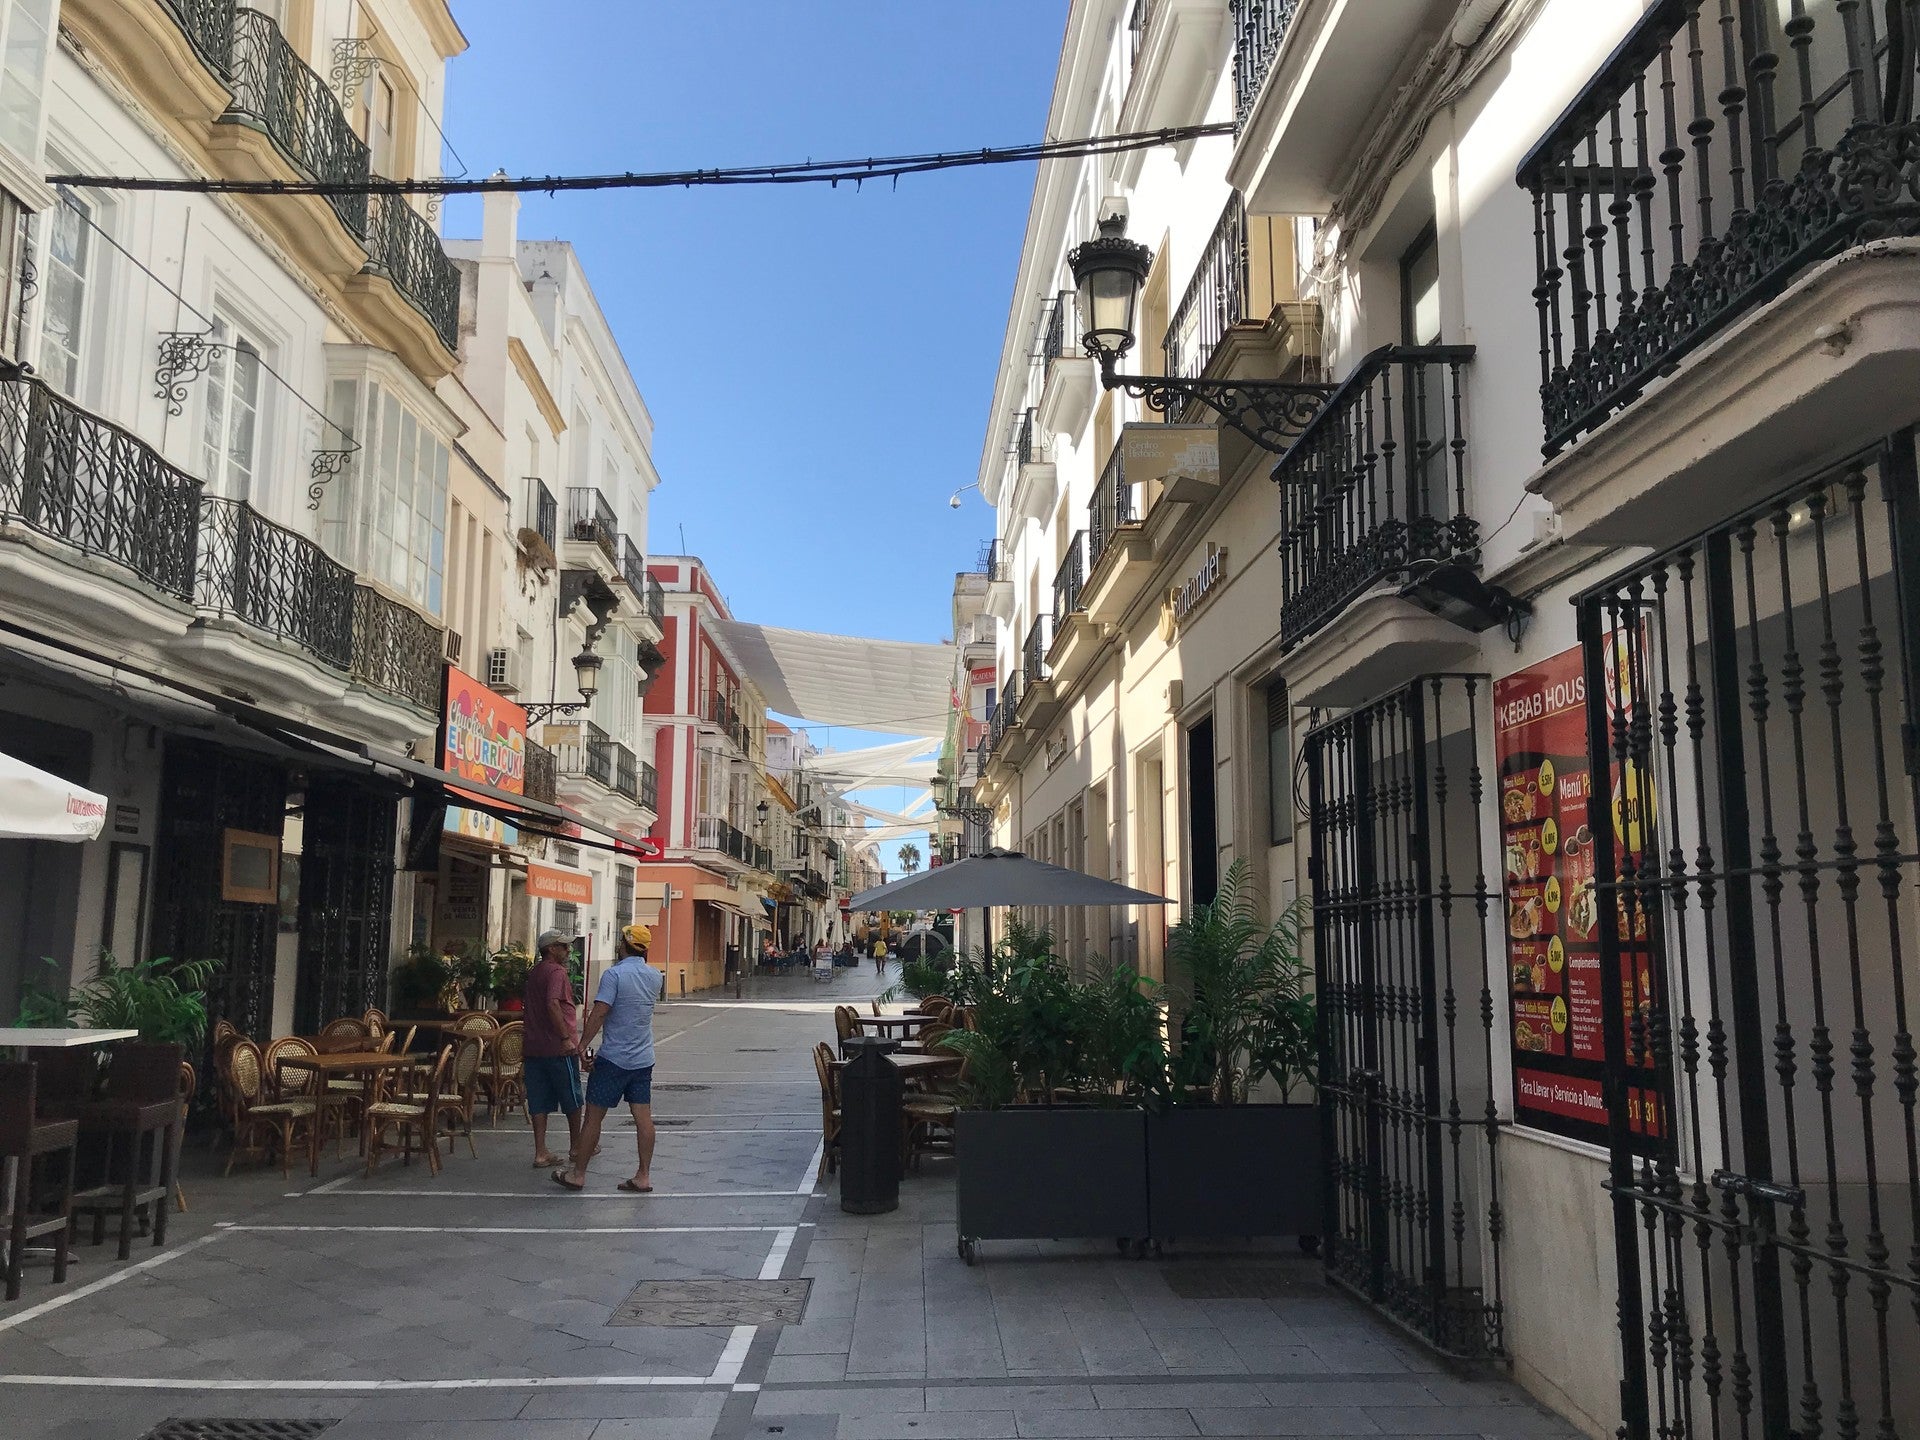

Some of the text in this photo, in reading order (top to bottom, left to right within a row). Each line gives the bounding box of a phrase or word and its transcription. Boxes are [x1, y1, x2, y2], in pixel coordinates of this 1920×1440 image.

[1128, 440, 1159, 450] Centro
[1171, 541, 1223, 627] Santander
[972, 671, 996, 681] ACADEMI
[449, 699, 485, 738] Chuches
[1500, 675, 1586, 729] KEBAB HOUS
[448, 724, 464, 758] EL
[1559, 775, 1581, 800] Menú
[1569, 957, 1601, 971] Complementos
[1520, 1077, 1533, 1095] Para
[1533, 1080, 1550, 1098] Llevar
[1550, 1087, 1554, 1103] y
[1554, 1084, 1578, 1104] Servicio
[1583, 1089, 1604, 1110] Domic
